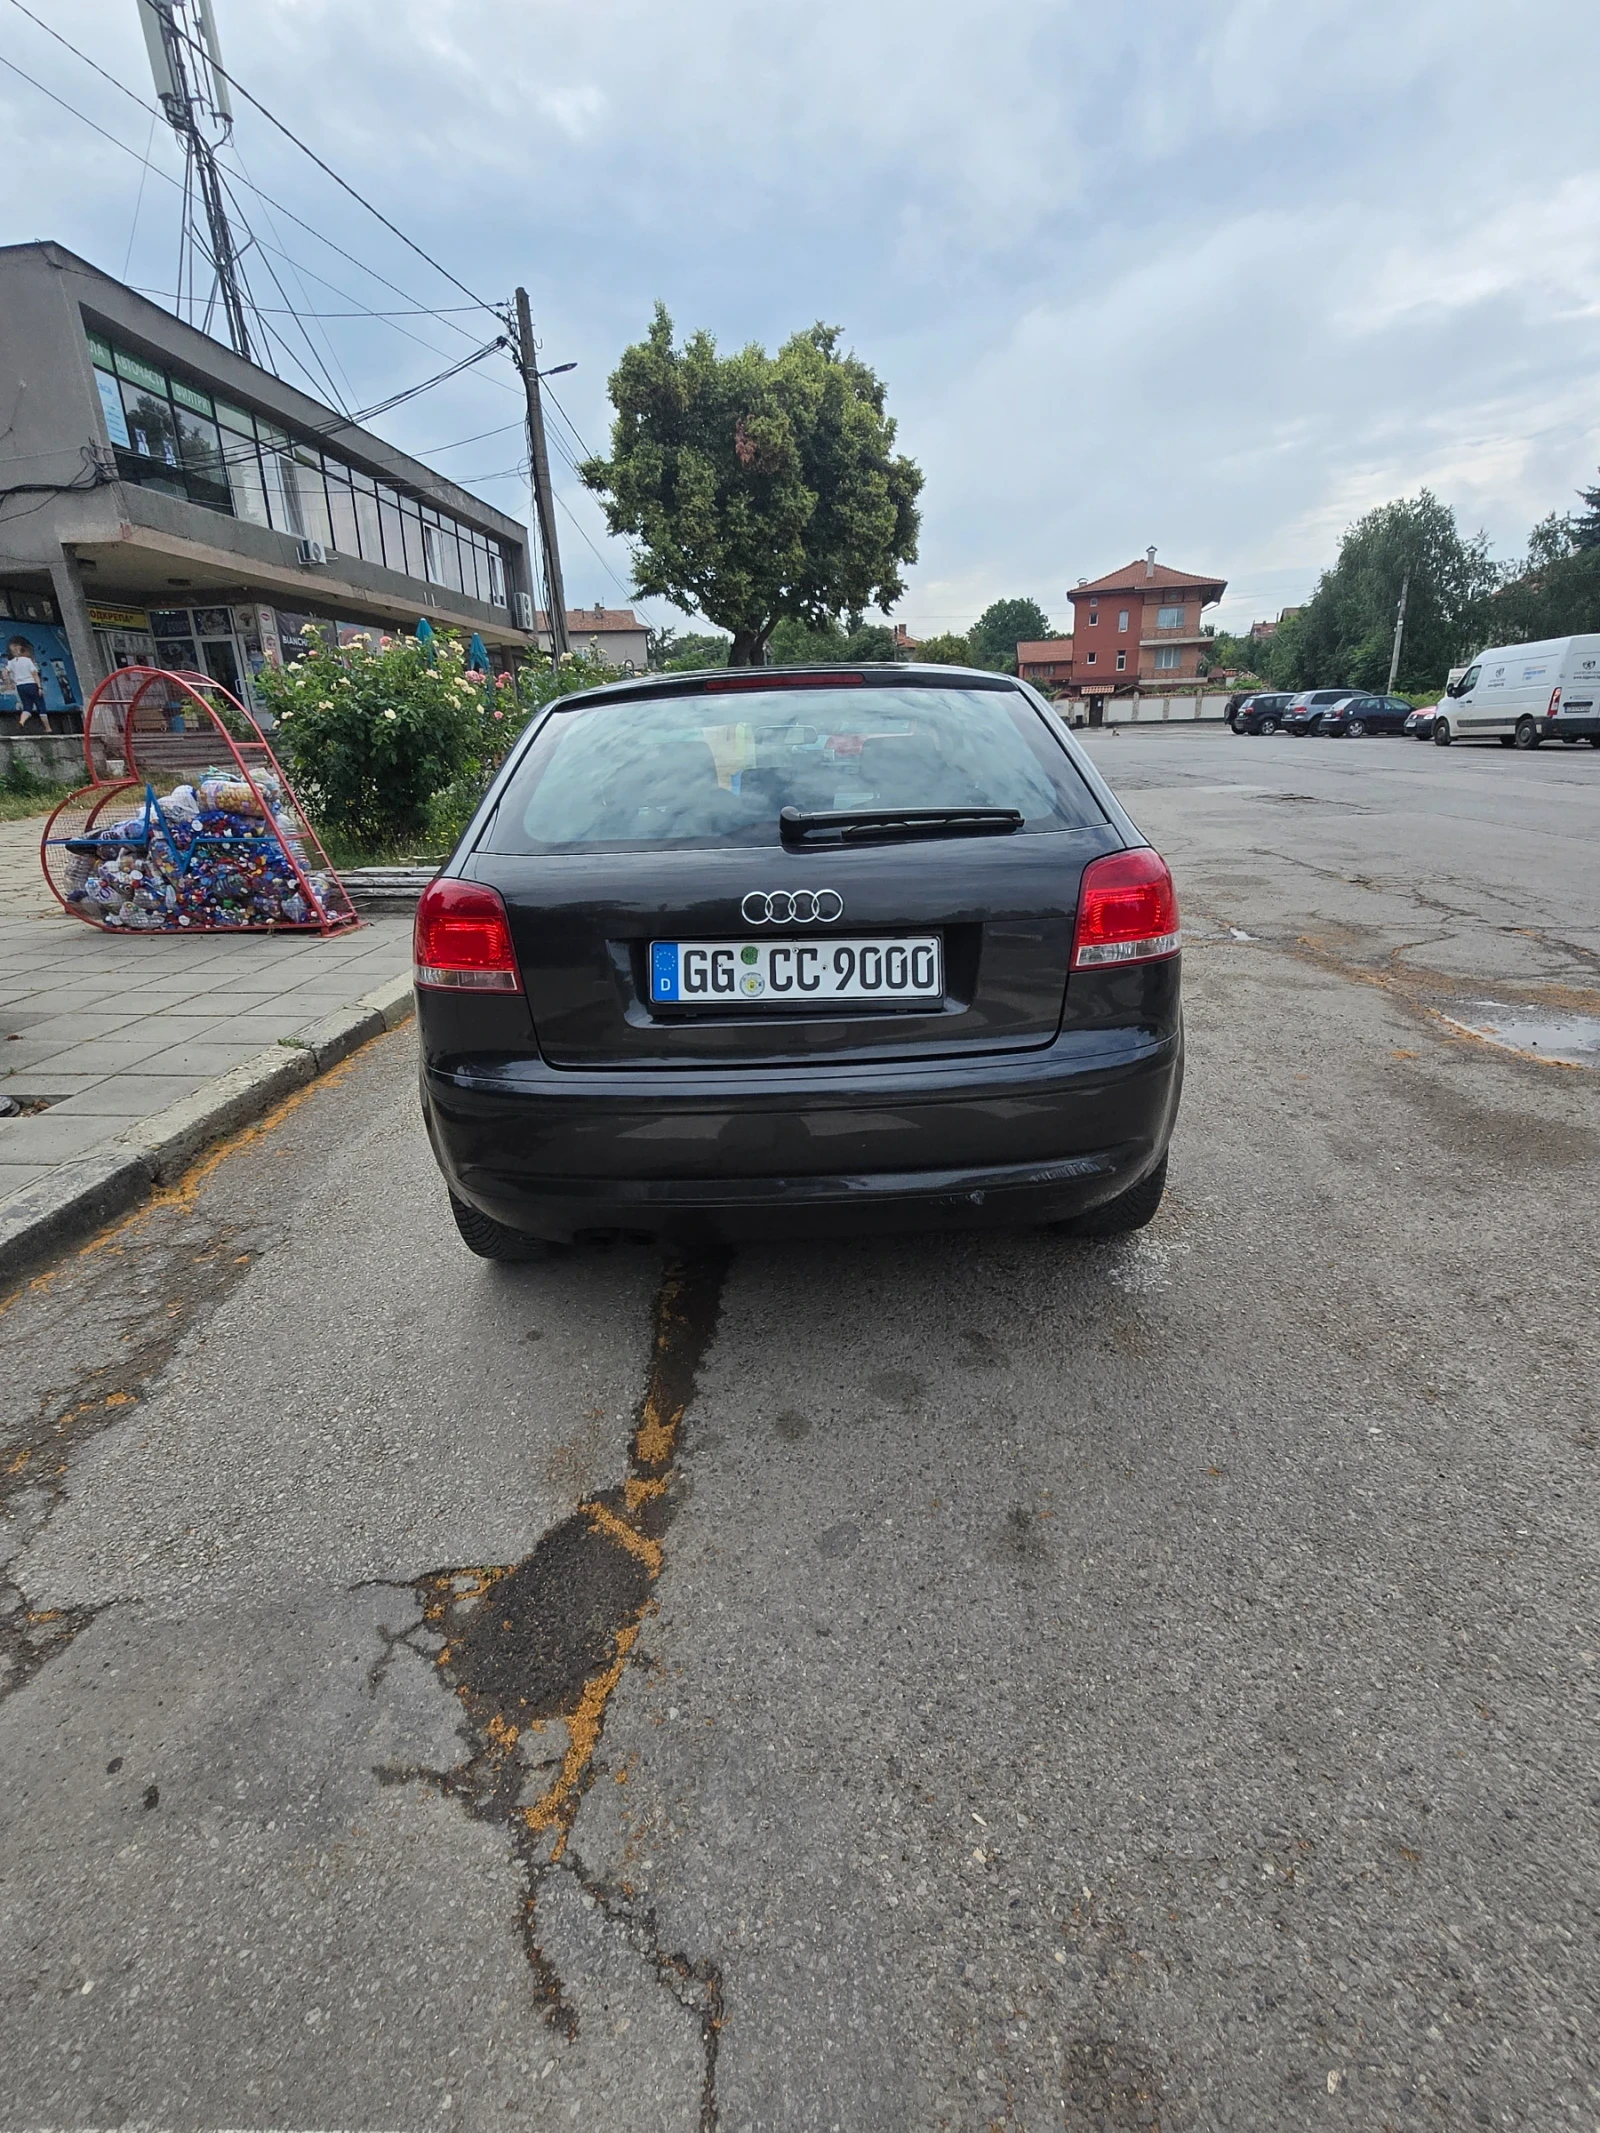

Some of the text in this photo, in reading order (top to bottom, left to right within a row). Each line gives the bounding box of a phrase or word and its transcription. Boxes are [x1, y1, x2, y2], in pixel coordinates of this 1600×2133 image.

[89, 339, 209, 410] ЛА АВТОЧАСТИ ФИЛТРИ
[90, 609, 133, 623] ОДКРЕПА"
[282, 635, 308, 646] BIANCH
[683, 950, 735, 993] GG
[769, 948, 820, 992] CC
[833, 946, 934, 991] 9000
[660, 978, 671, 991] D
